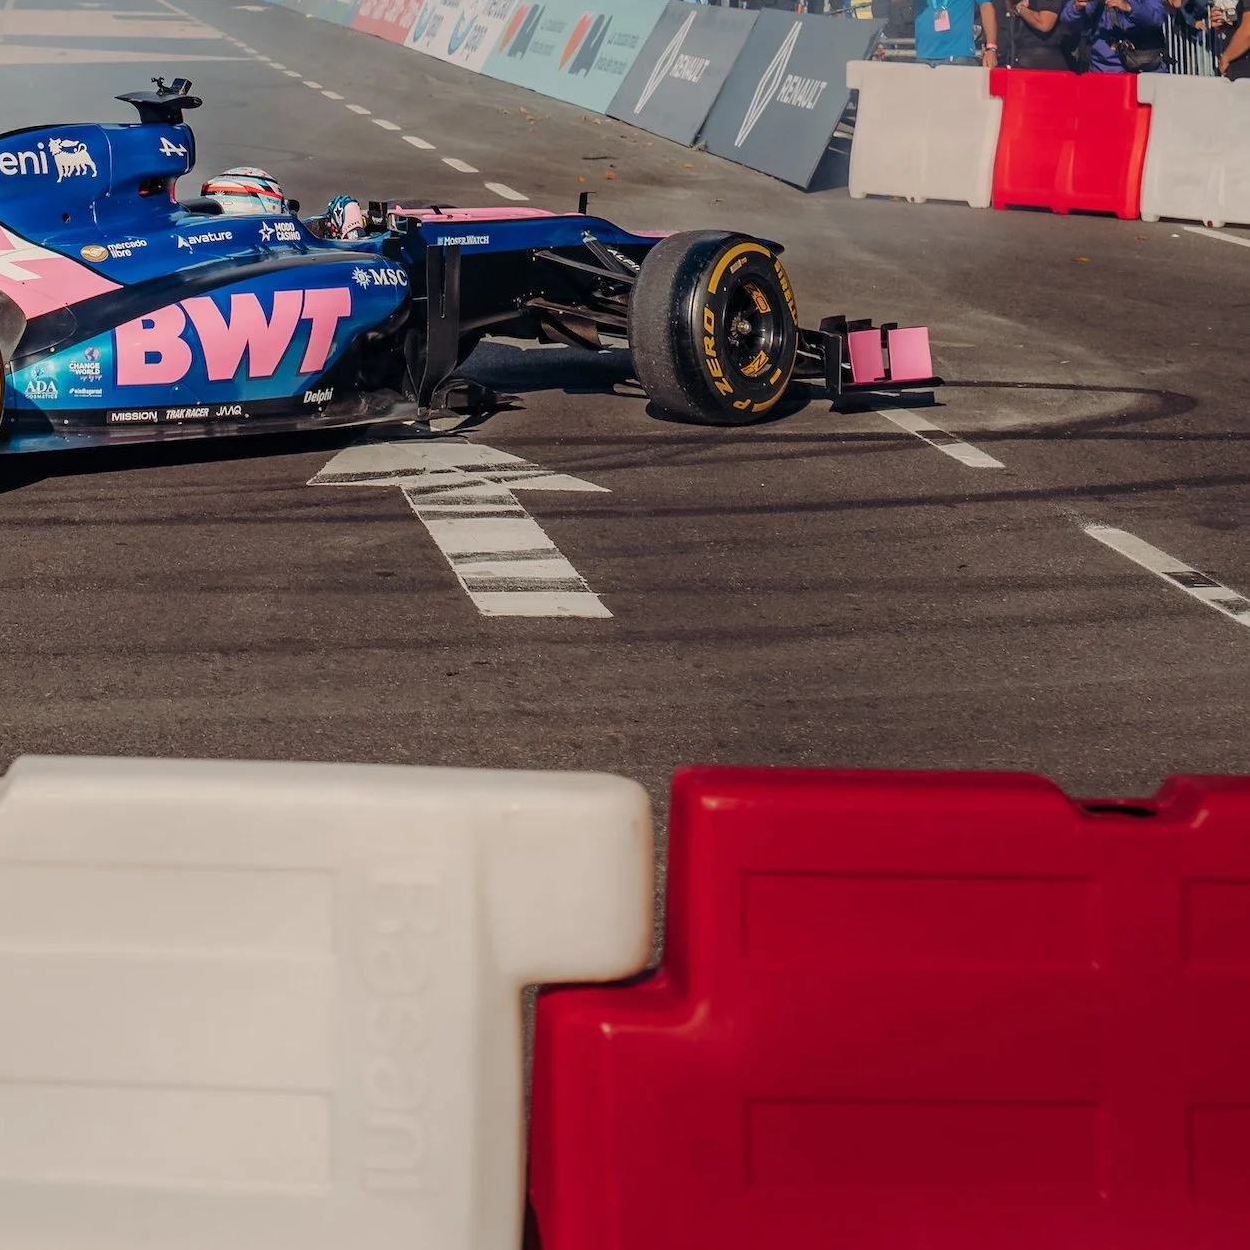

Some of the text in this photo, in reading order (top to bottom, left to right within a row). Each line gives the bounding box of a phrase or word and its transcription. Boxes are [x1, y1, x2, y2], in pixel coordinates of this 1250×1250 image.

[670, 53, 710, 83] RENAULT
[776, 74, 828, 110] RENAULT
[273, 222, 296, 232] MODO
[187, 230, 233, 245] avature
[275, 230, 302, 241] CASINO
[107, 238, 148, 251] mercado
[110, 248, 133, 259] libre
[369, 268, 408, 287] MSC
[114, 287, 352, 387] BWT
[703, 306, 734, 397] ZERO
[24, 380, 57, 393] ADA
[303, 388, 334, 405] Delphi
[111, 410, 158, 422] MISSION
[165, 408, 185, 420] TRAK
[185, 407, 210, 418] RACER
